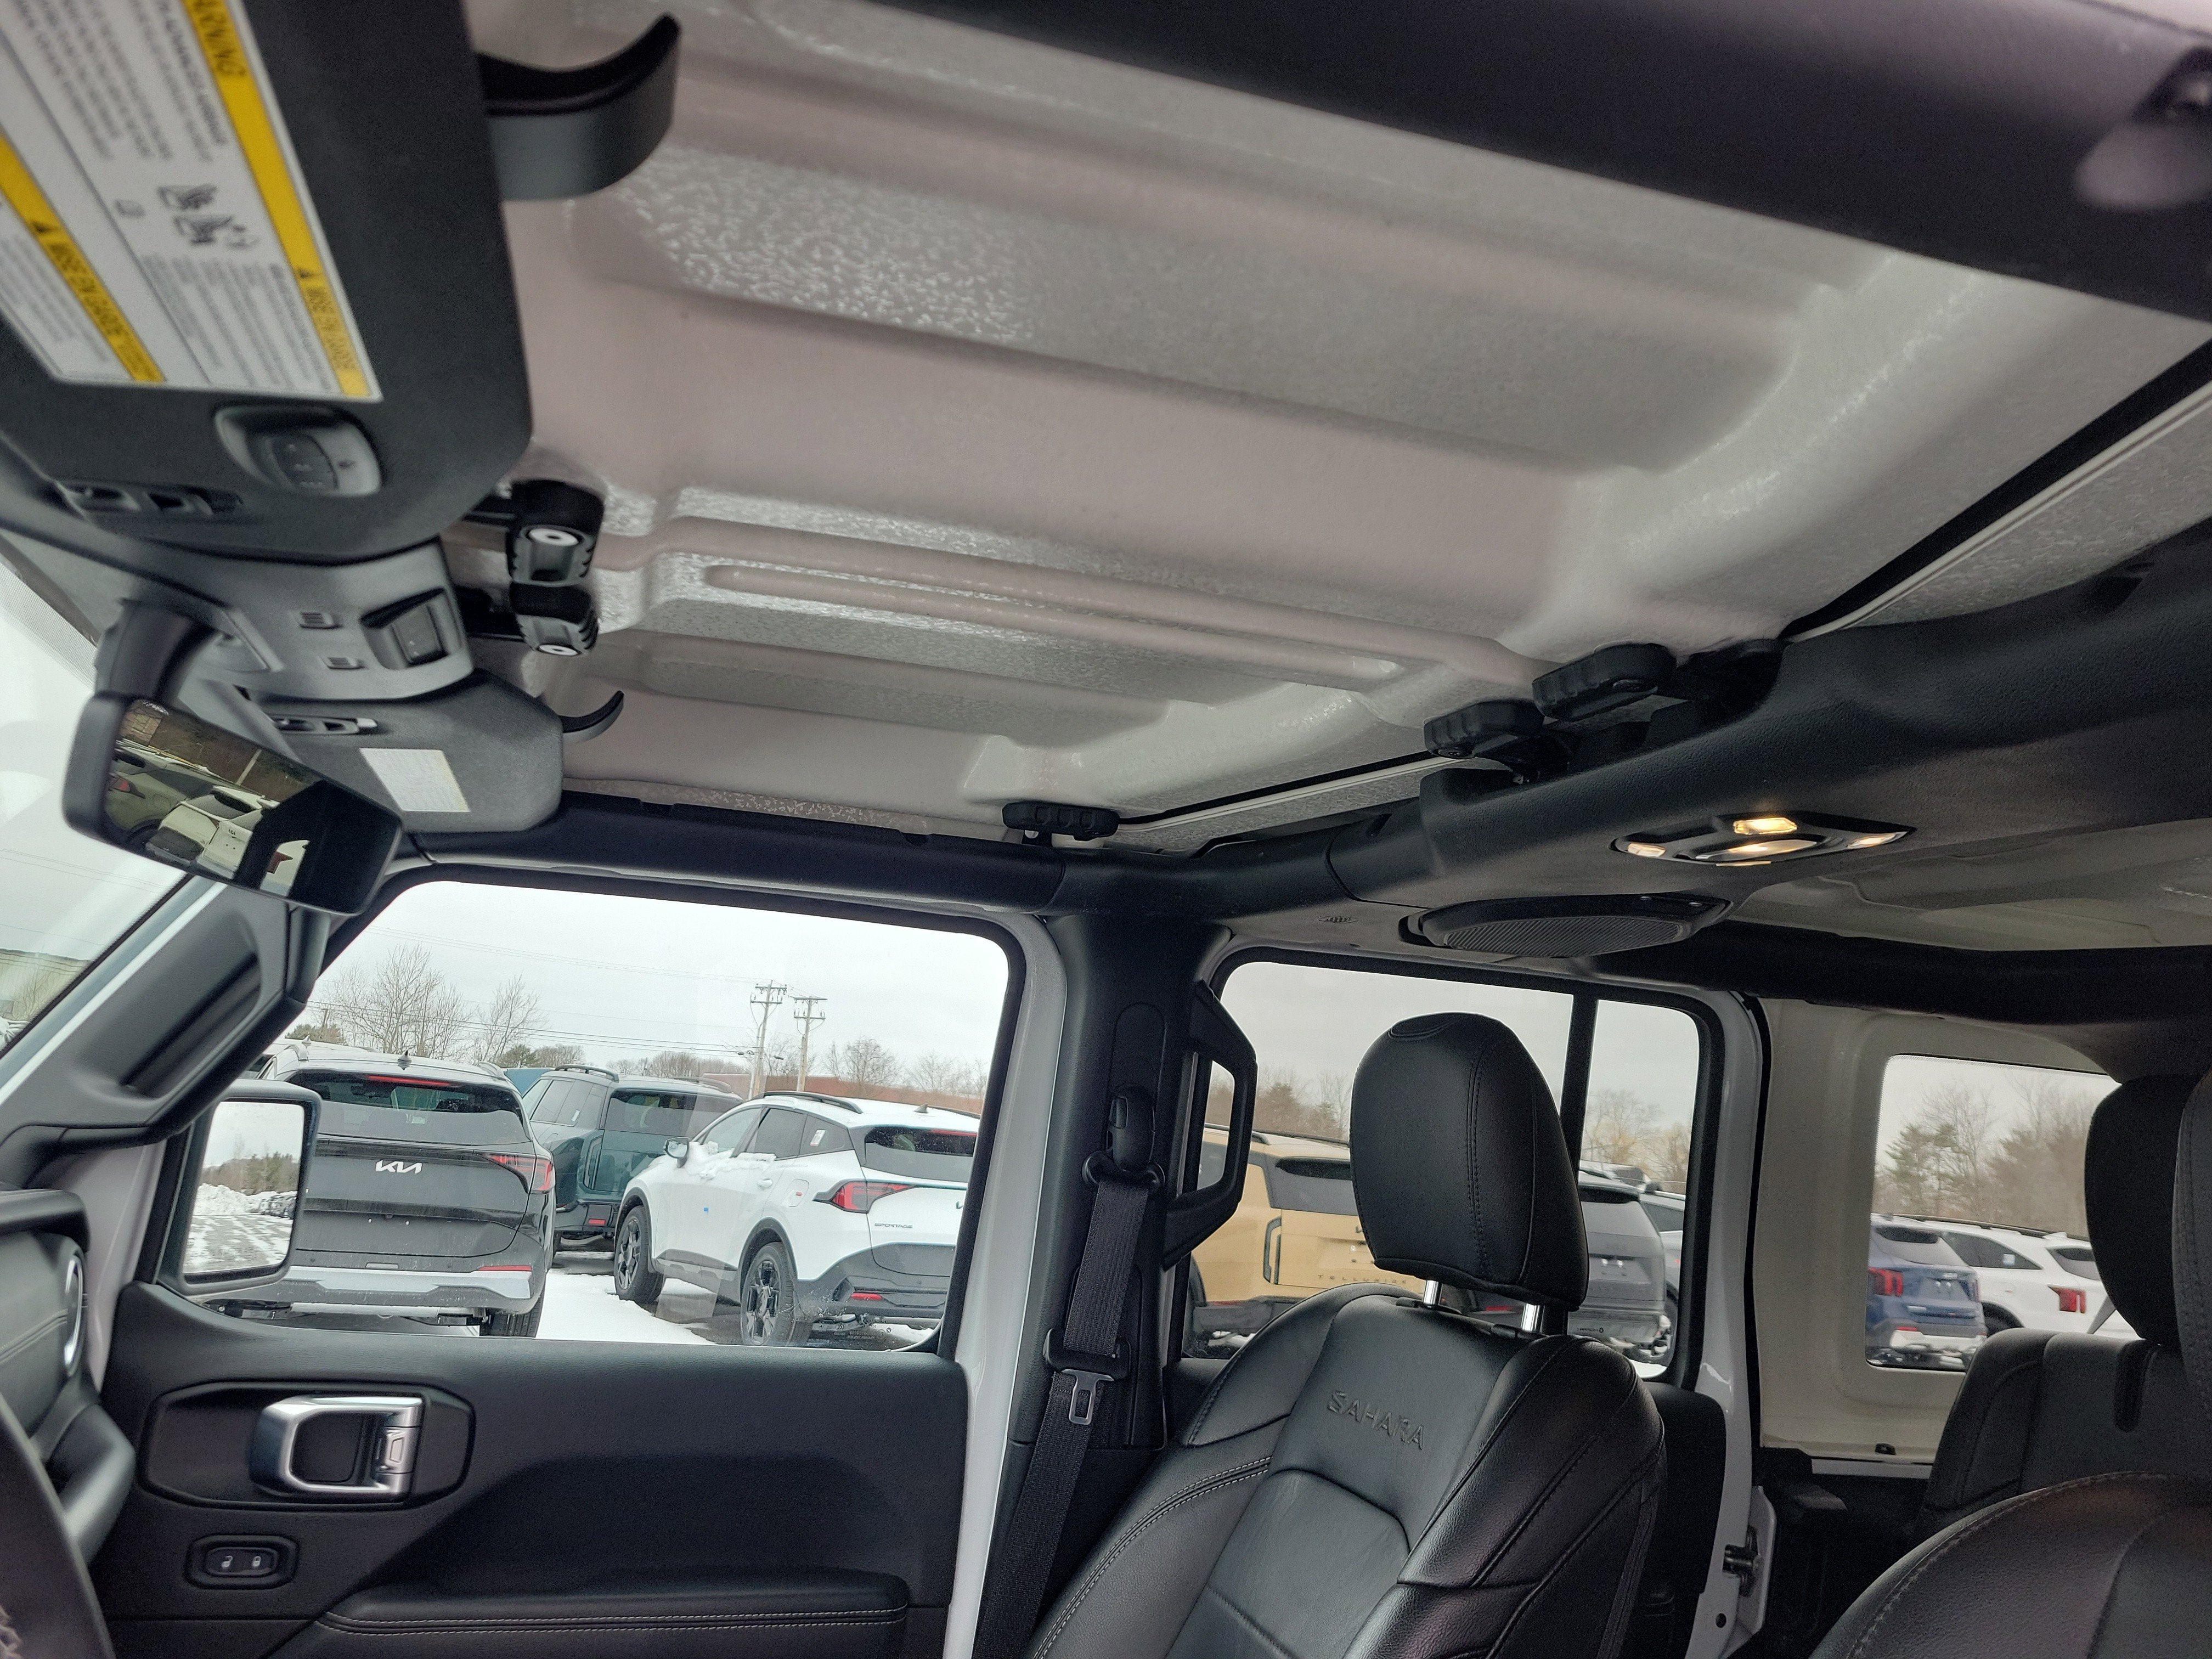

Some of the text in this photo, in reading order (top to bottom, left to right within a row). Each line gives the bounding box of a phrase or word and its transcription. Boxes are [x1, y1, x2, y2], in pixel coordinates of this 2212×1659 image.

[375, 1160, 422, 1174] KIA
[1318, 1274, 1407, 1284] TELLURIDE
[1327, 1390, 1424, 1450] SAHARA
